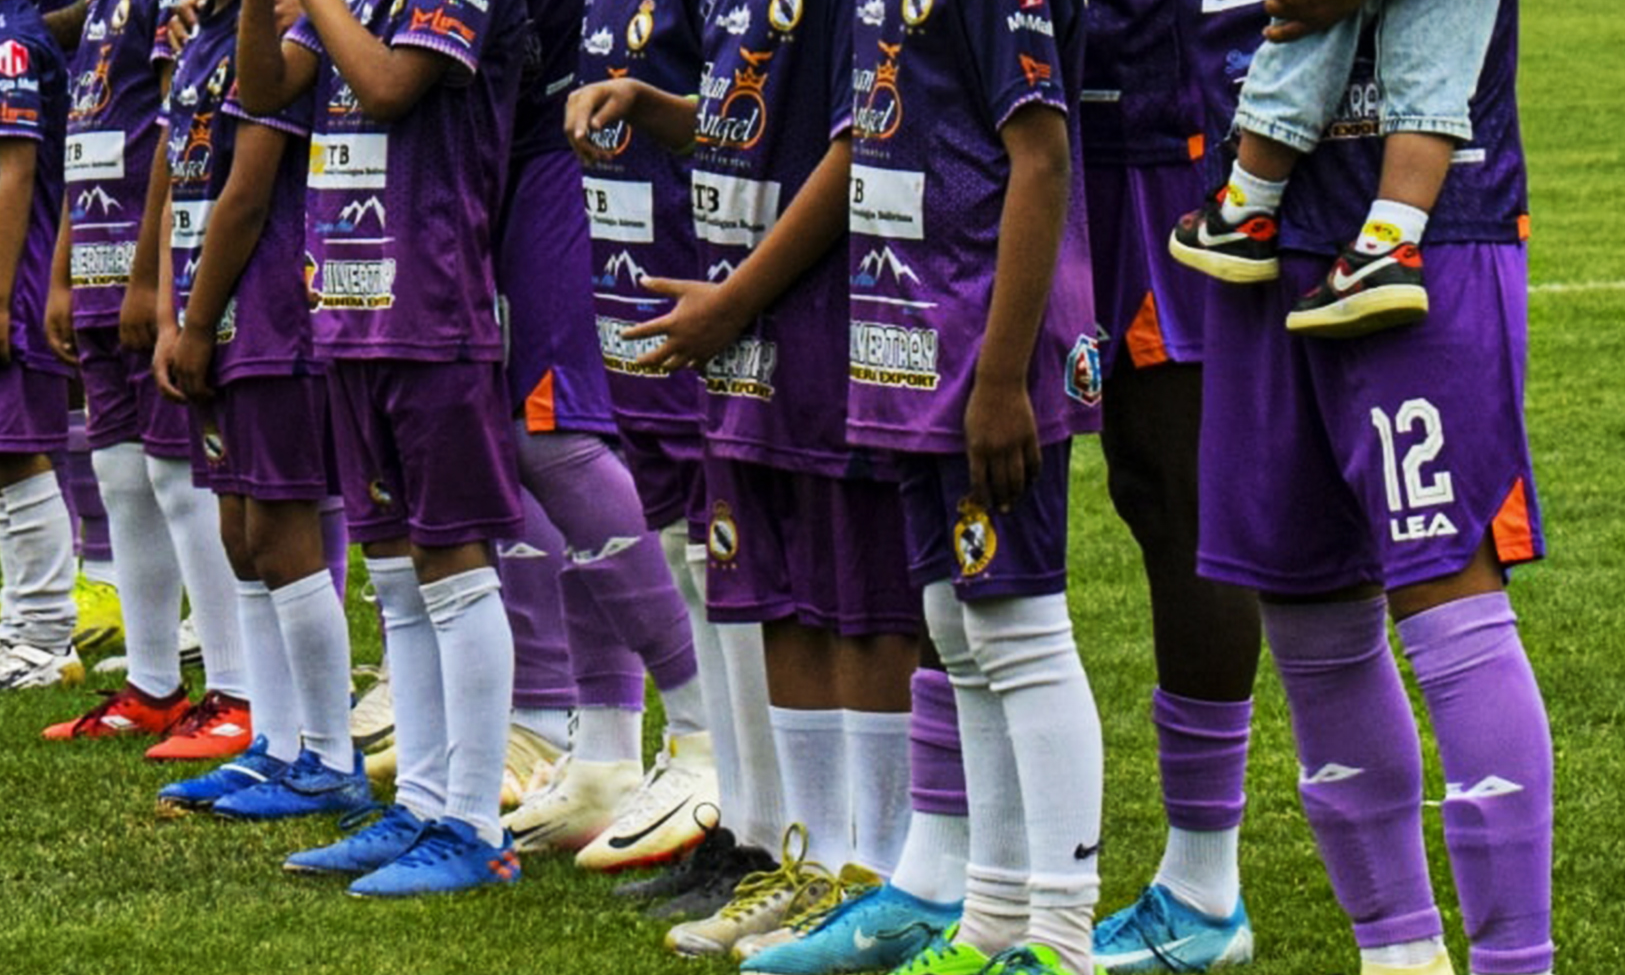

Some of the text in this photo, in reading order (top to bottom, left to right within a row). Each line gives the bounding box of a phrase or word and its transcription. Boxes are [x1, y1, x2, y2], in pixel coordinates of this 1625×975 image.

[879, 371, 937, 388] EXPORT
[1370, 397, 1455, 512] 12
[1390, 512, 1459, 542] LEA
